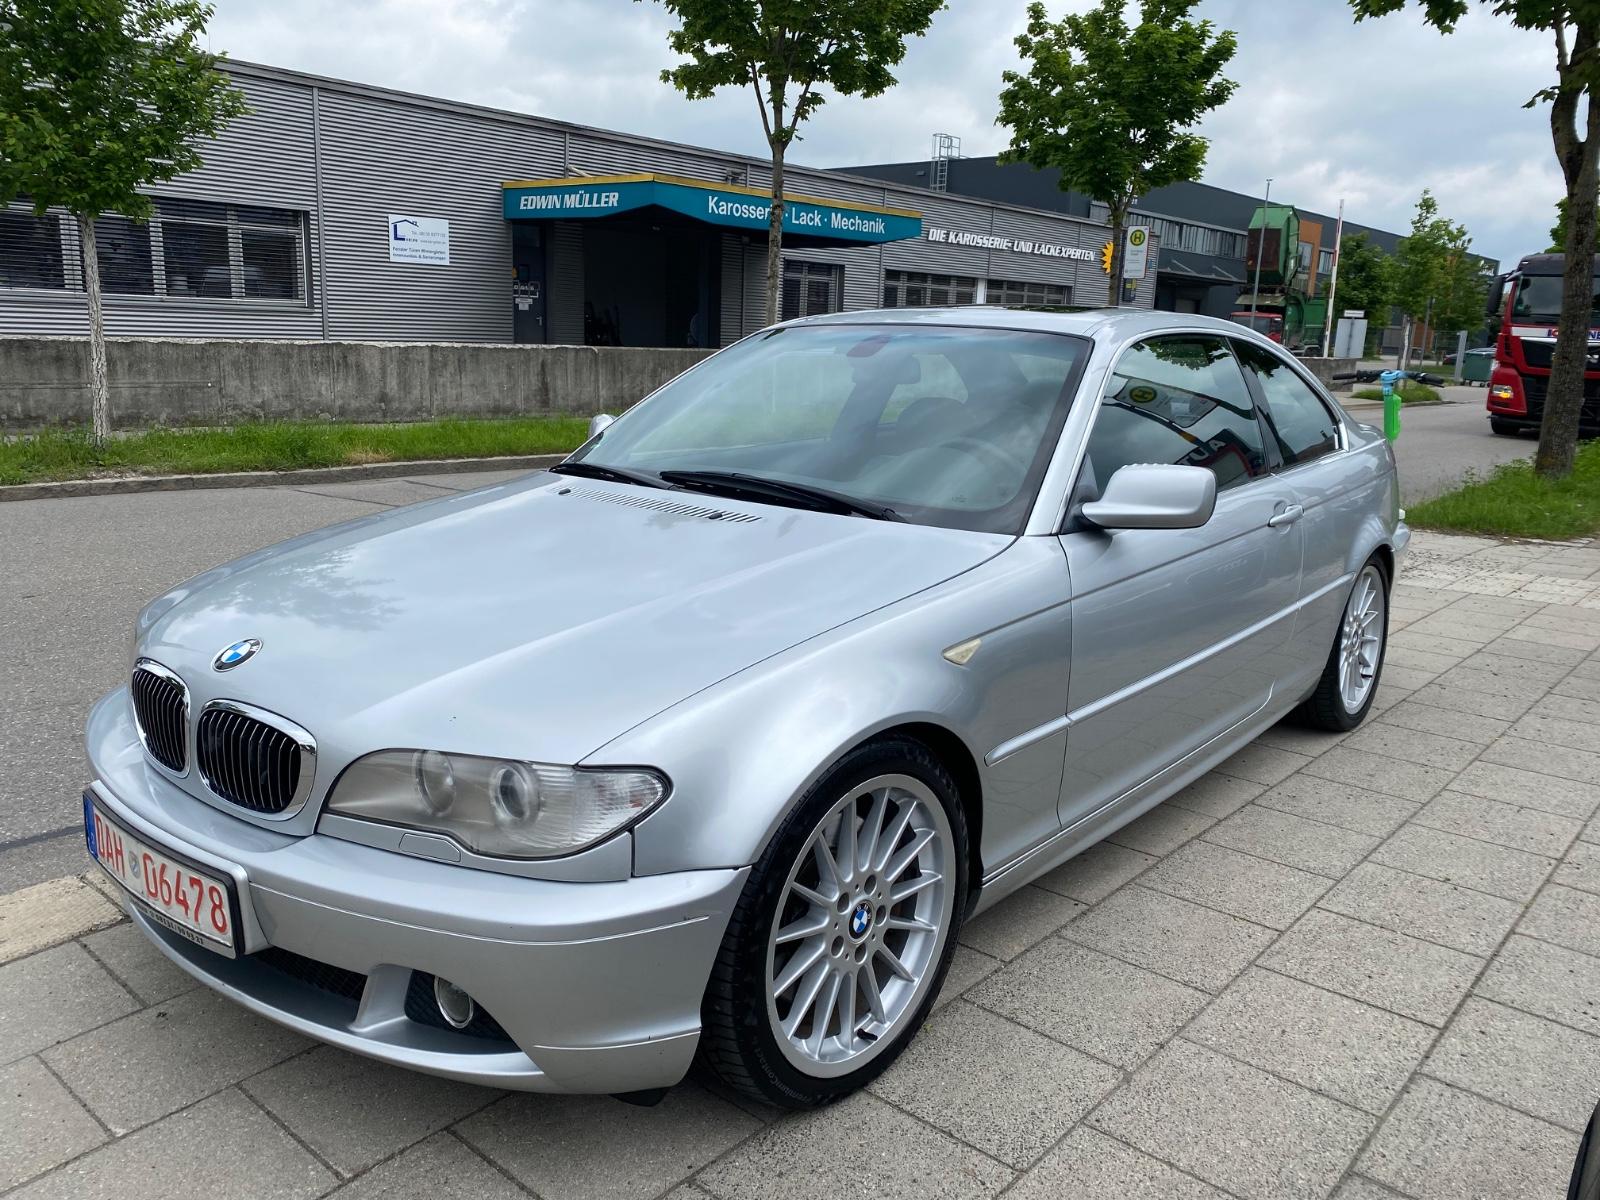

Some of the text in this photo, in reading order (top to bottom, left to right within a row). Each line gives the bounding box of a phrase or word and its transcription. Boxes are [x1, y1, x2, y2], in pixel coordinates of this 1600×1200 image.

[520, 190, 619, 210] EDWIN MÜLLER
[708, 195, 885, 234] Karosser Lack Mechanik
[928, 228, 1096, 261] DIE KAROSSERIE- UND LACKEXPERTEN
[94, 813, 228, 934] DAH 06478
